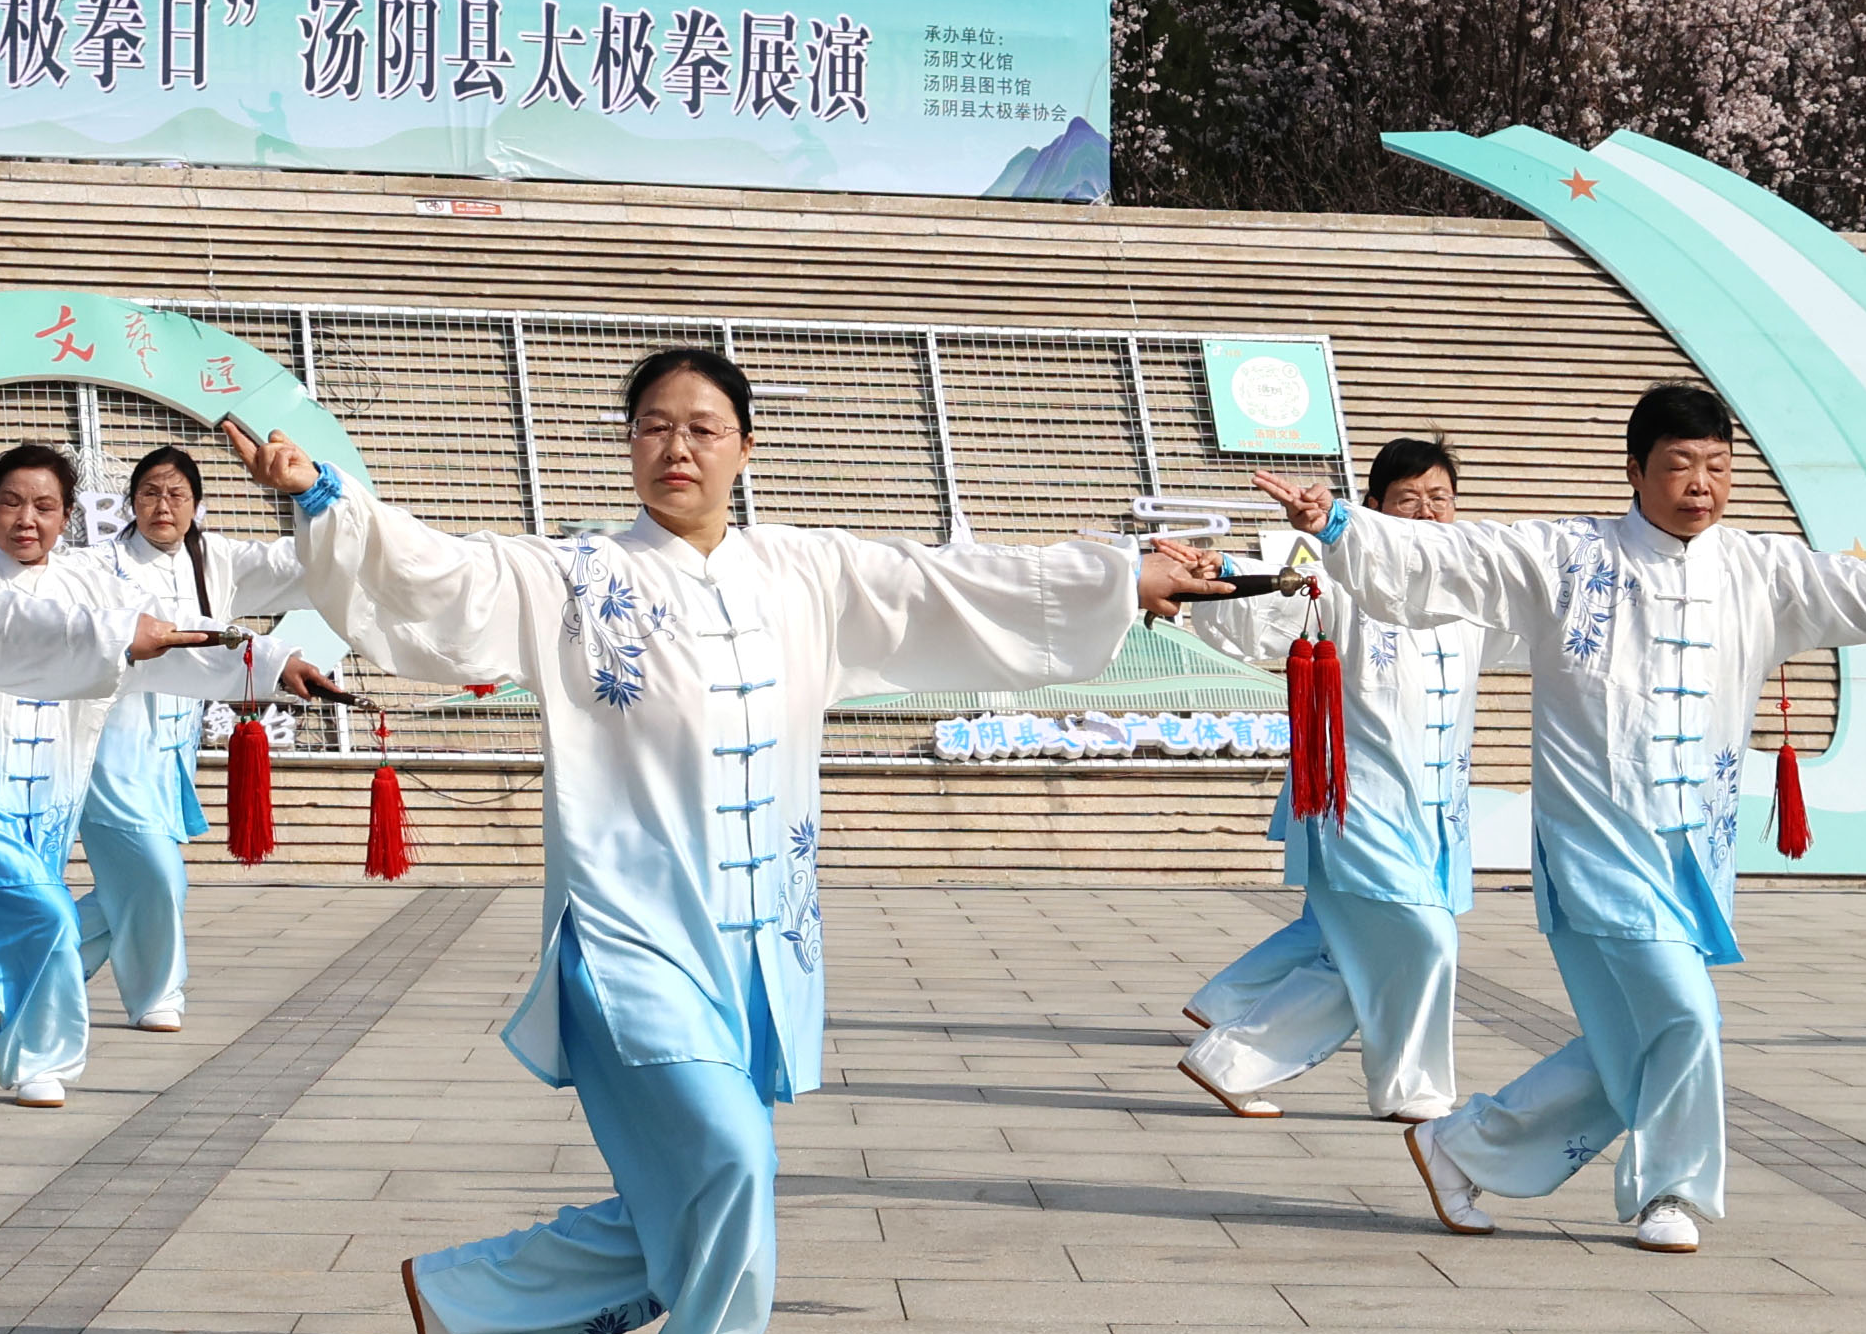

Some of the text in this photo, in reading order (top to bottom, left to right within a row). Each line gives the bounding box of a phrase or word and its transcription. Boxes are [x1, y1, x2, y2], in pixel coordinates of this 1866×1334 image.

[924, 24, 1004, 47] 承办单位：
[923, 49, 1014, 72] 汤阴文化馆
[923, 73, 1032, 97] 汤阴县图书馆
[922, 98, 1068, 122] 汤阴县太极拳协会
